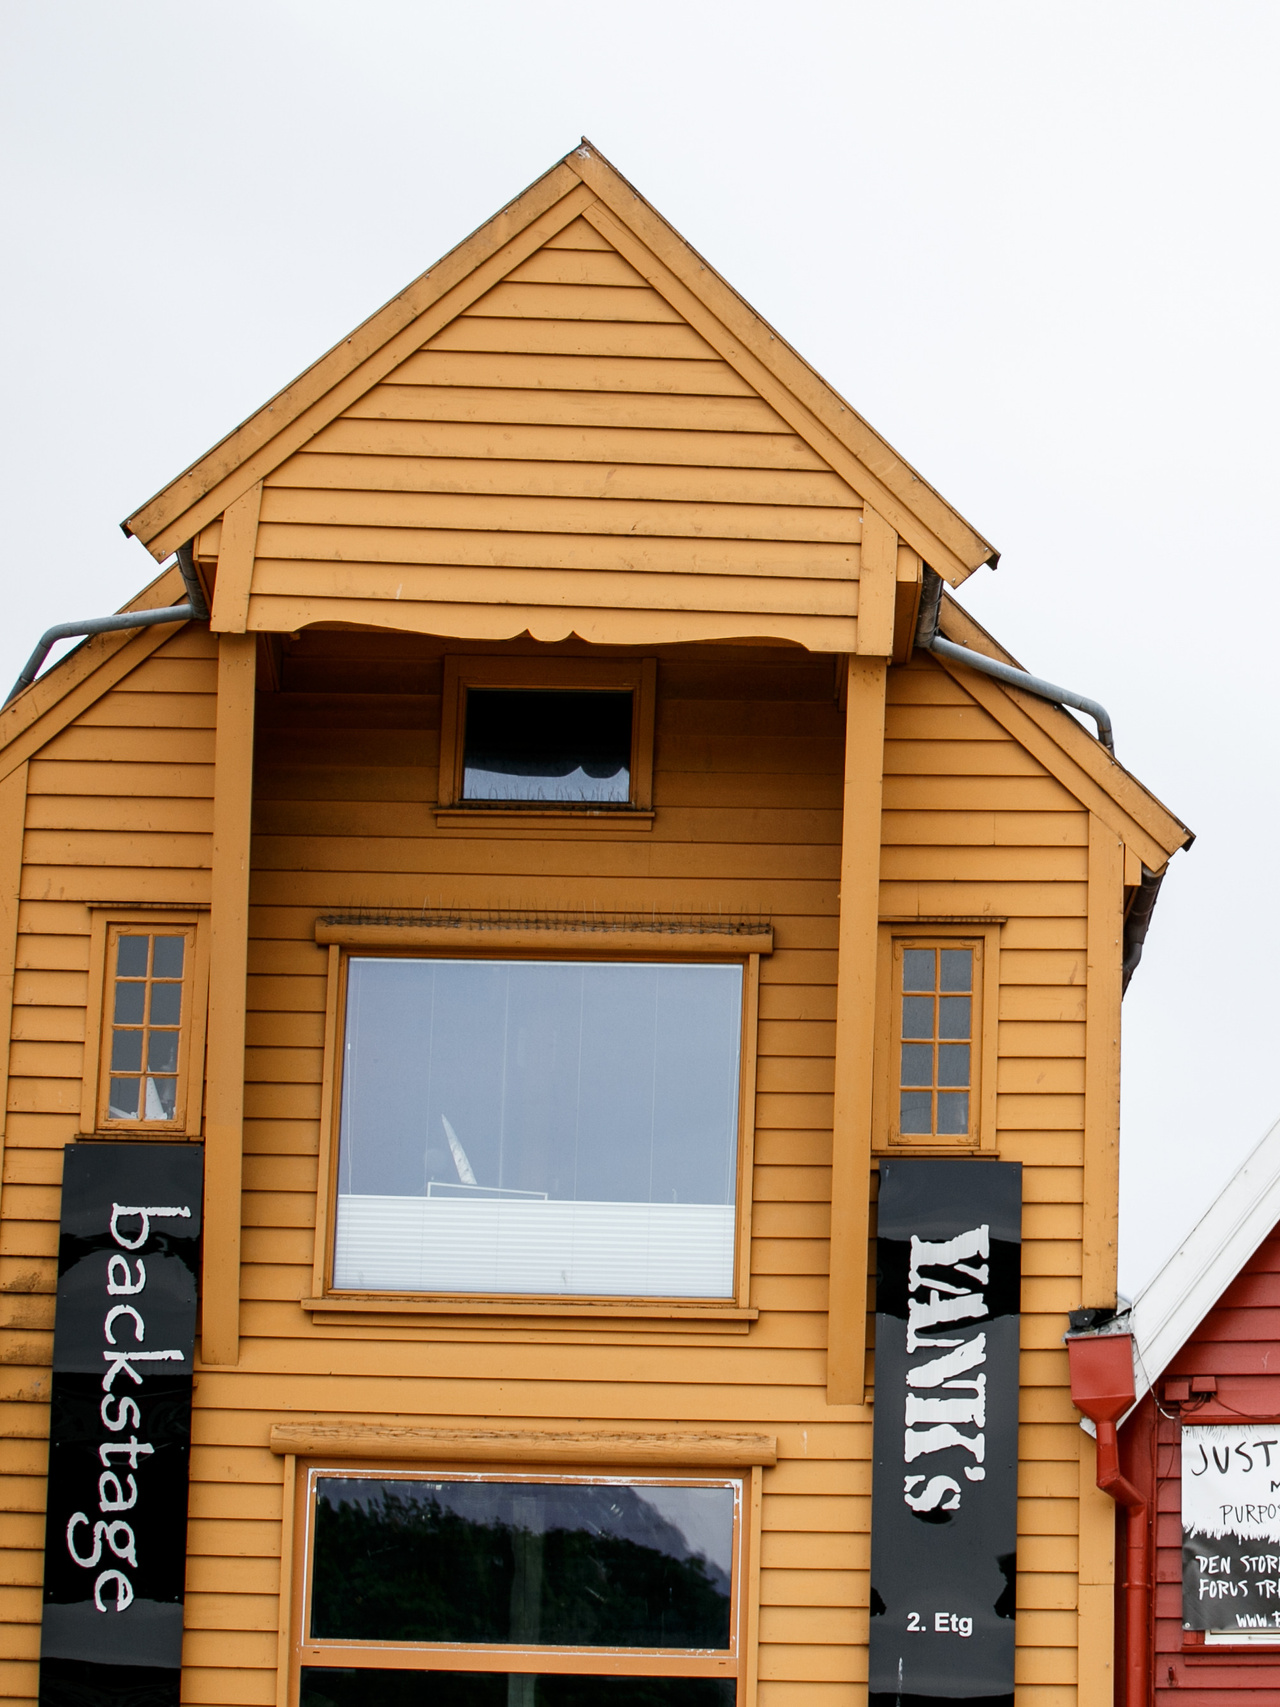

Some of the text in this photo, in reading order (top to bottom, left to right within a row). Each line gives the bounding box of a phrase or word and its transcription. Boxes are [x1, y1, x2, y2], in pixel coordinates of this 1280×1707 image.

[66, 1202, 192, 1614] backstage
[1195, 1554, 1231, 1574] DEN
[1198, 1578, 1249, 1600] FORUS
[906, 1611, 974, 1638] 2. Etg
